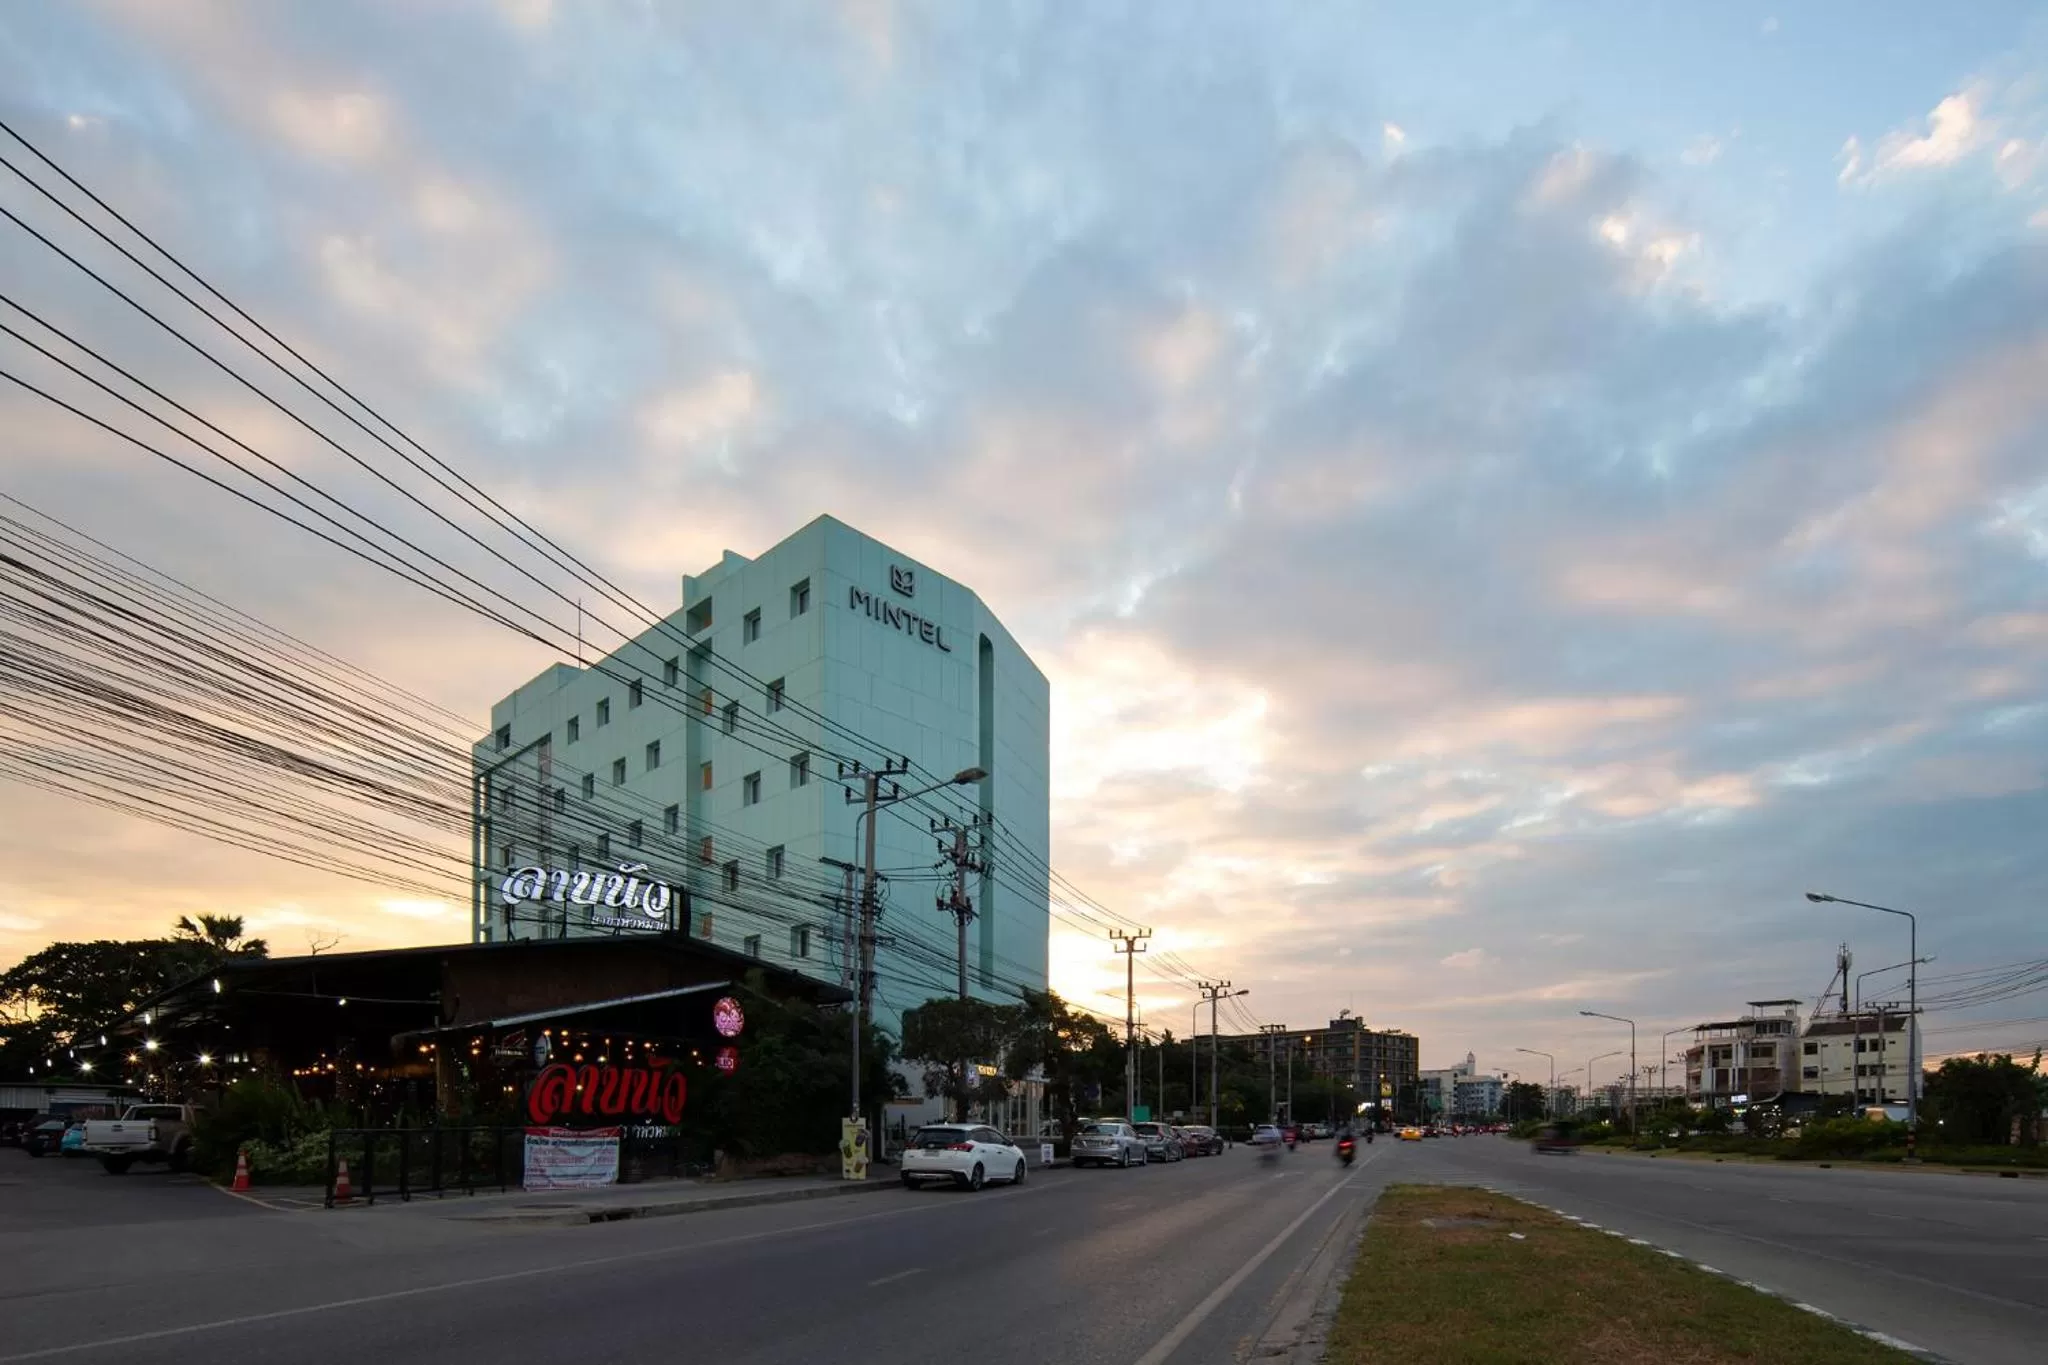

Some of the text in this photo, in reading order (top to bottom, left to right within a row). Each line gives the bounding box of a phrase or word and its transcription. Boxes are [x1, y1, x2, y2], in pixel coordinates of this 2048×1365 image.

[850, 585, 952, 653] MINTEL
[502, 863, 671, 918] ลาบนัว
